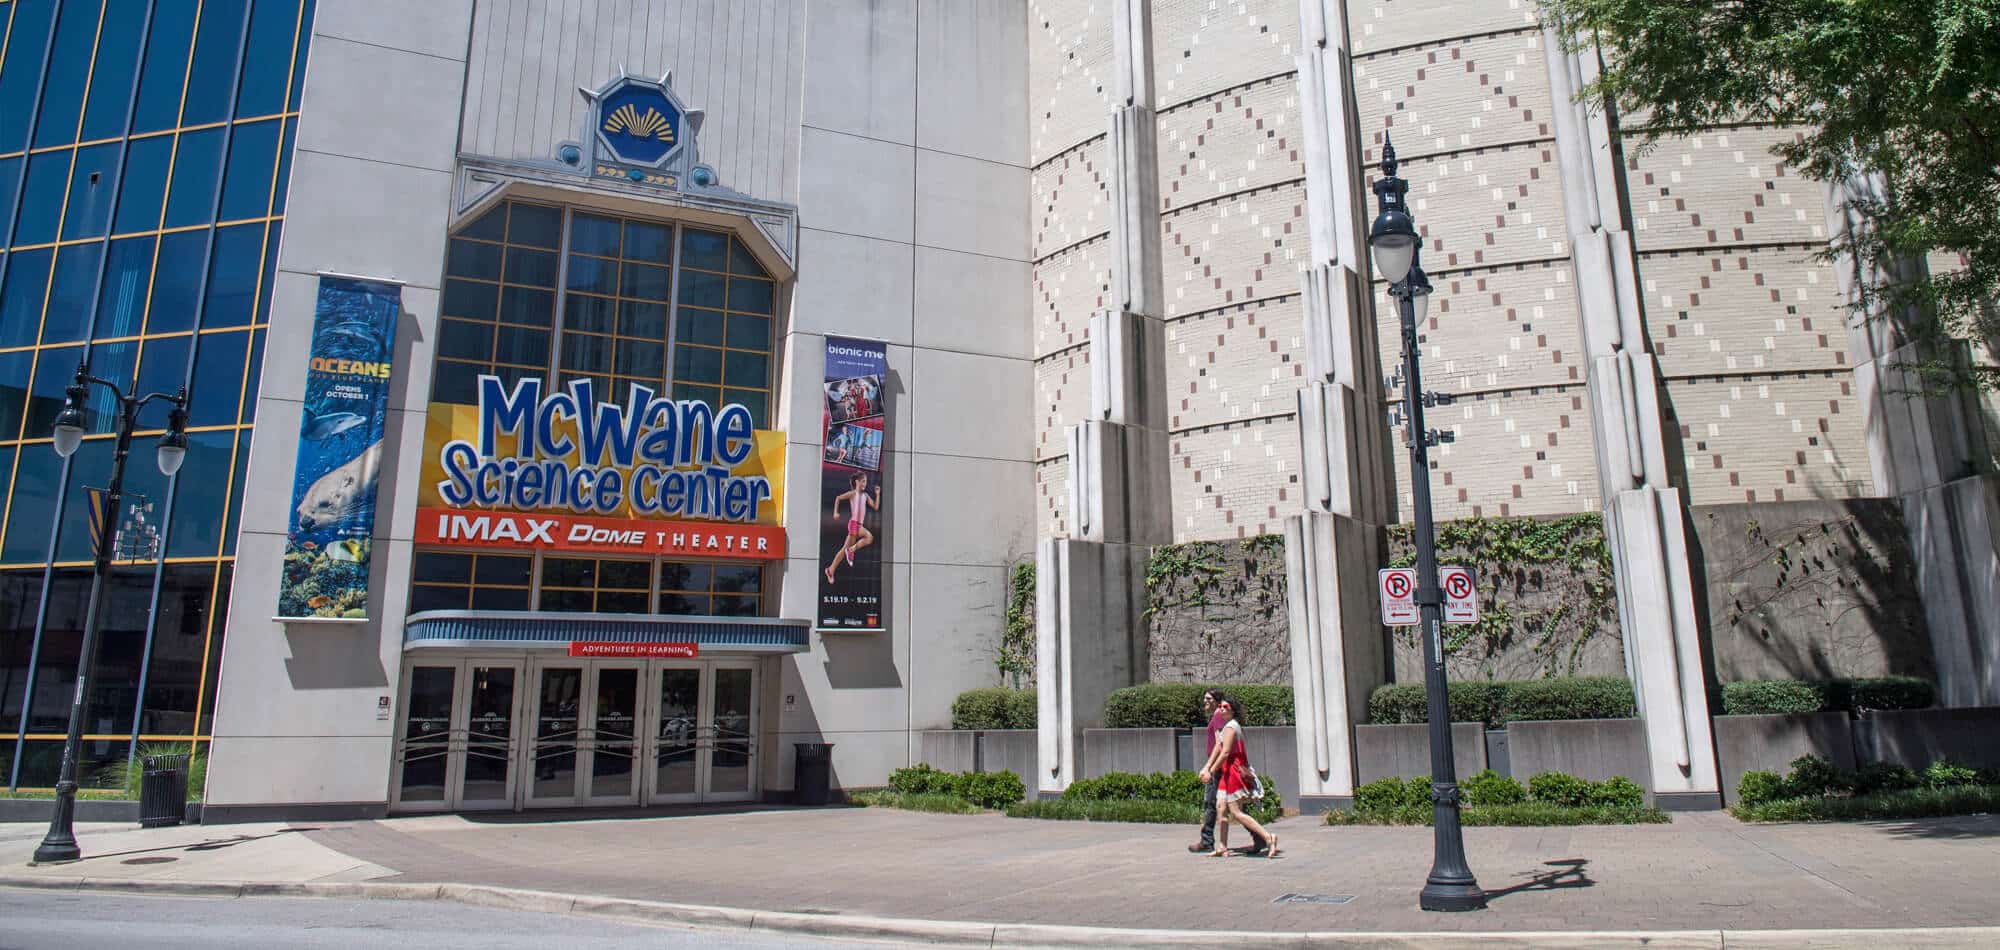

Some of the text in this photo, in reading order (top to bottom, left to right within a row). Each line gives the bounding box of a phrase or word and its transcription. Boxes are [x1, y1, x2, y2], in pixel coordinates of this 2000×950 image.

[828, 343, 885, 360] bionic me
[310, 357, 391, 378] OCEANS
[326, 391, 364, 399] OCTOBER
[478, 374, 754, 471] McWane
[437, 440, 772, 522] Science Center
[567, 523, 646, 545] DOME
[656, 532, 768, 550] THEATER
[1447, 601, 1458, 609] ANY
[582, 645, 636, 653] ADVENTURES
